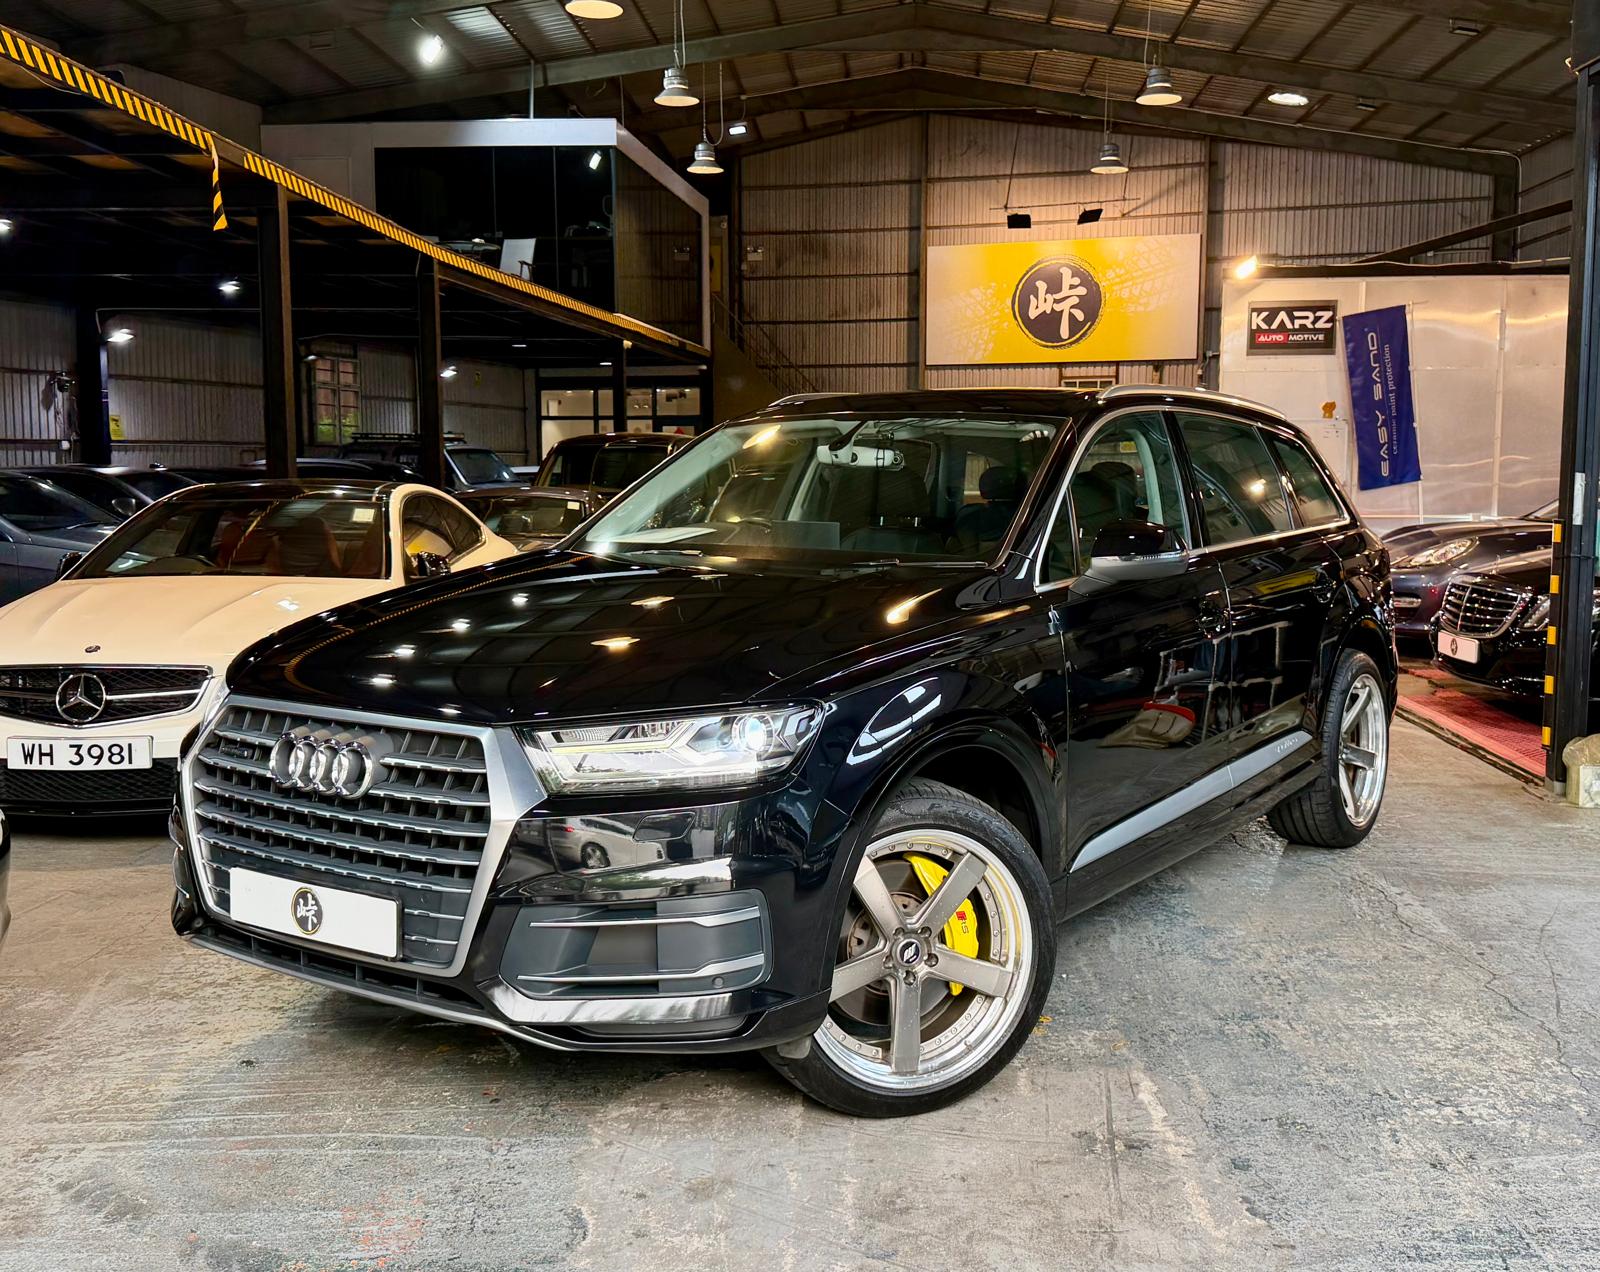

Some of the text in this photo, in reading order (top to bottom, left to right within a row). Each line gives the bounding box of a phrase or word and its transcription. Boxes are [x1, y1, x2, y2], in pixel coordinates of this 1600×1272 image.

[1028, 266, 1088, 340] 峠
[1251, 310, 1334, 330] KARZ
[1258, 334, 1284, 342] AUTO
[1383, 344, 1396, 390] protection
[1367, 332, 1390, 477] EASY SAND
[1388, 392, 1396, 416] paint
[21, 743, 133, 766] WH 3981
[296, 892, 319, 932] 峠
